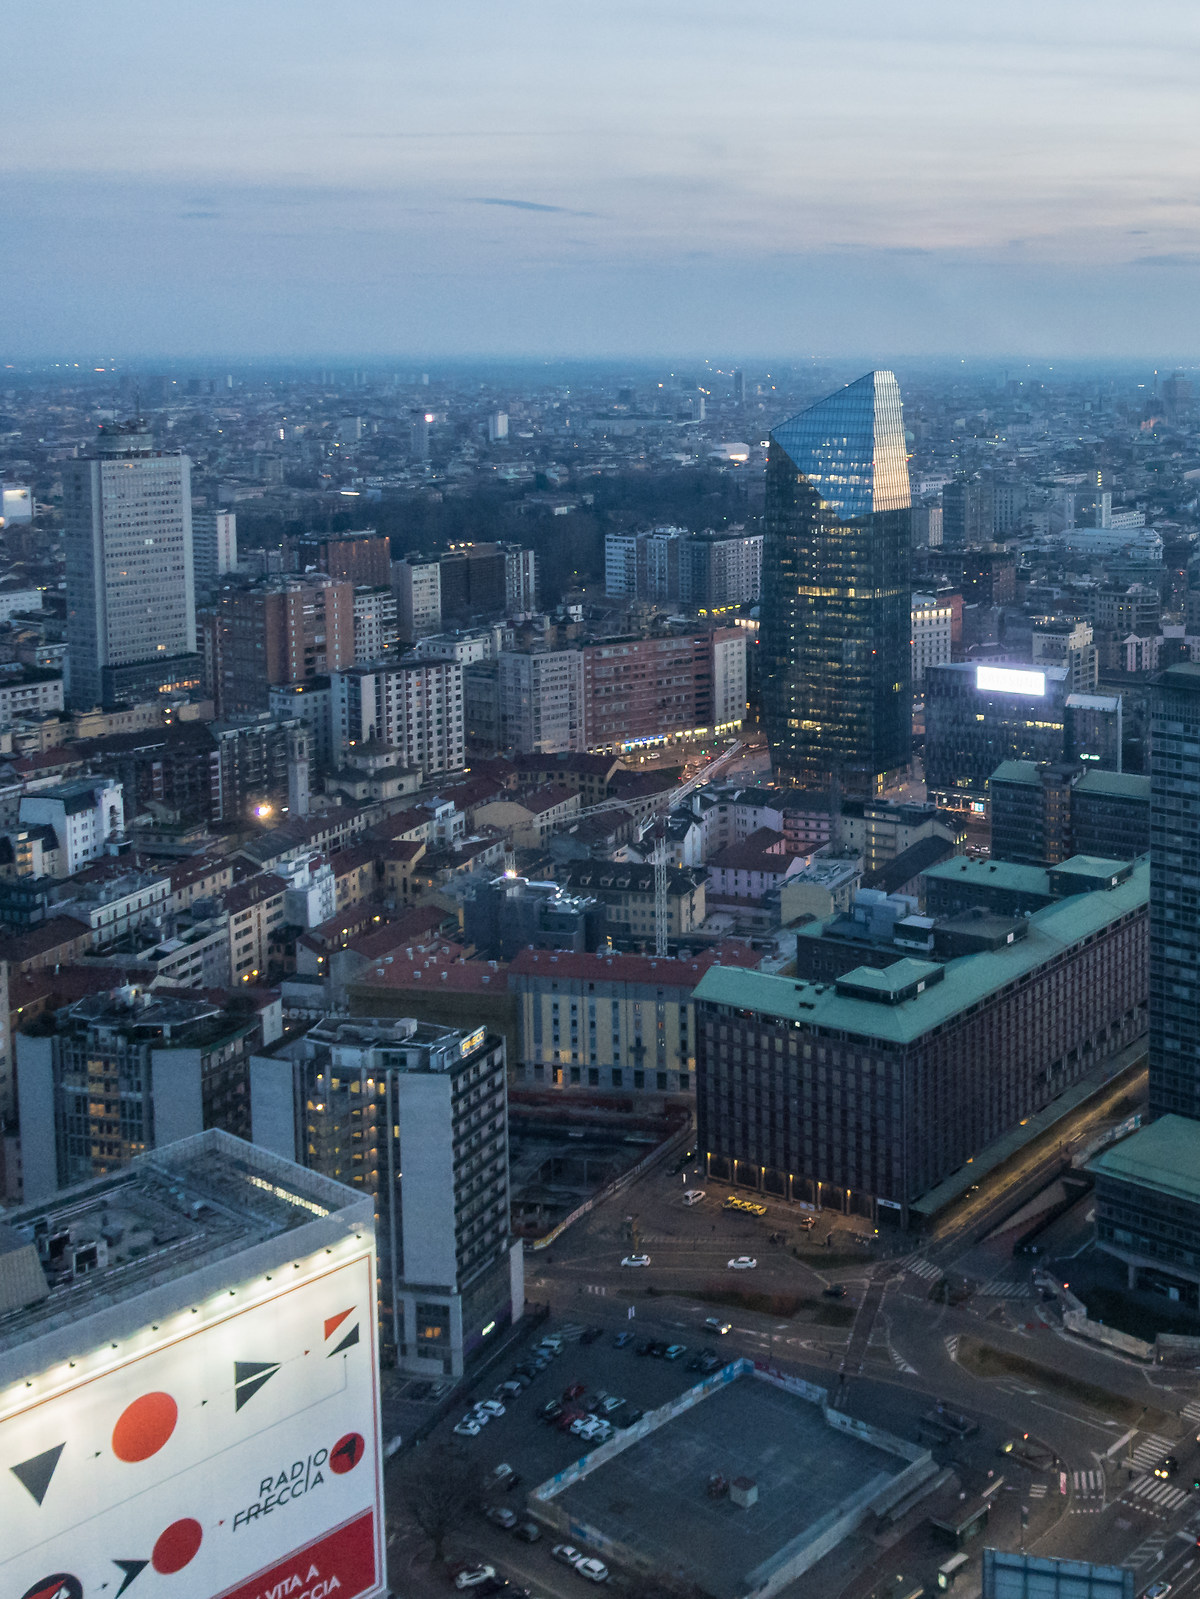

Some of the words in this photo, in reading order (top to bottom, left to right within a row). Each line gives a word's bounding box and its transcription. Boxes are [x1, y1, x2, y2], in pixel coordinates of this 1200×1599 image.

[259, 1448, 328, 1498] RADIO
[233, 1470, 325, 1532] FRECCIA
[305, 1564, 319, 1583] A
